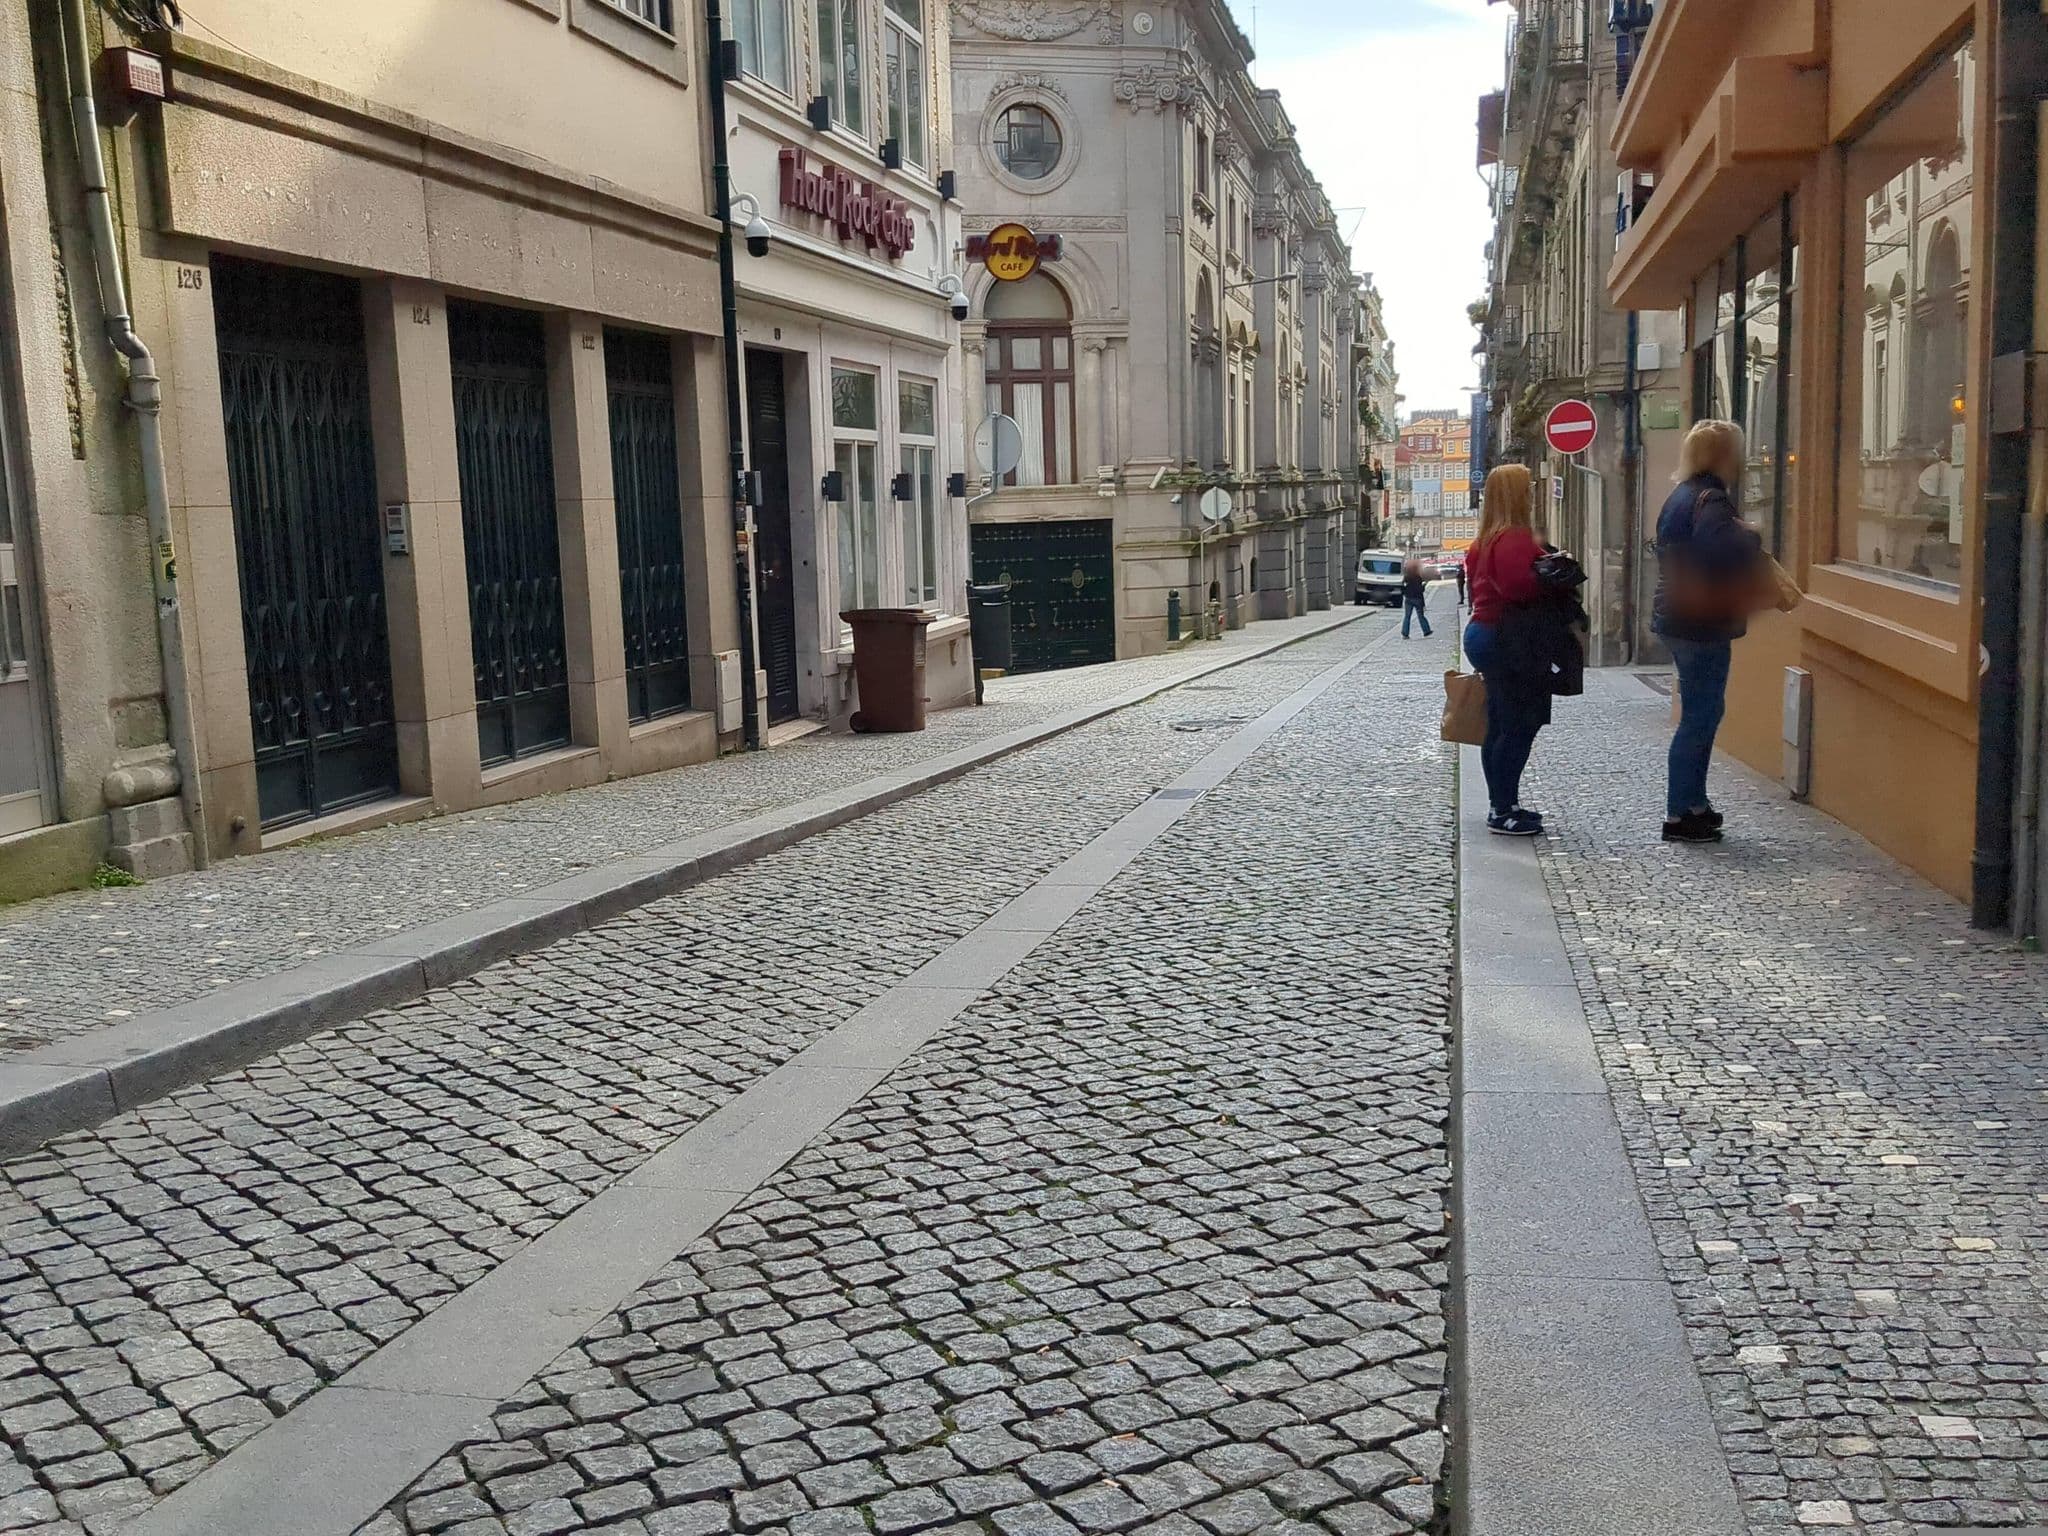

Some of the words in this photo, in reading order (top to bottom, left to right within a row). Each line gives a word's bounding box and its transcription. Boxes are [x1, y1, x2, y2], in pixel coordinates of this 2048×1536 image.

[779, 147, 838, 221] Hard
[837, 171, 880, 248] Rock
[177, 266, 203, 290] 126
[1000, 262, 1024, 272] CAFE
[412, 303, 431, 325] 124
